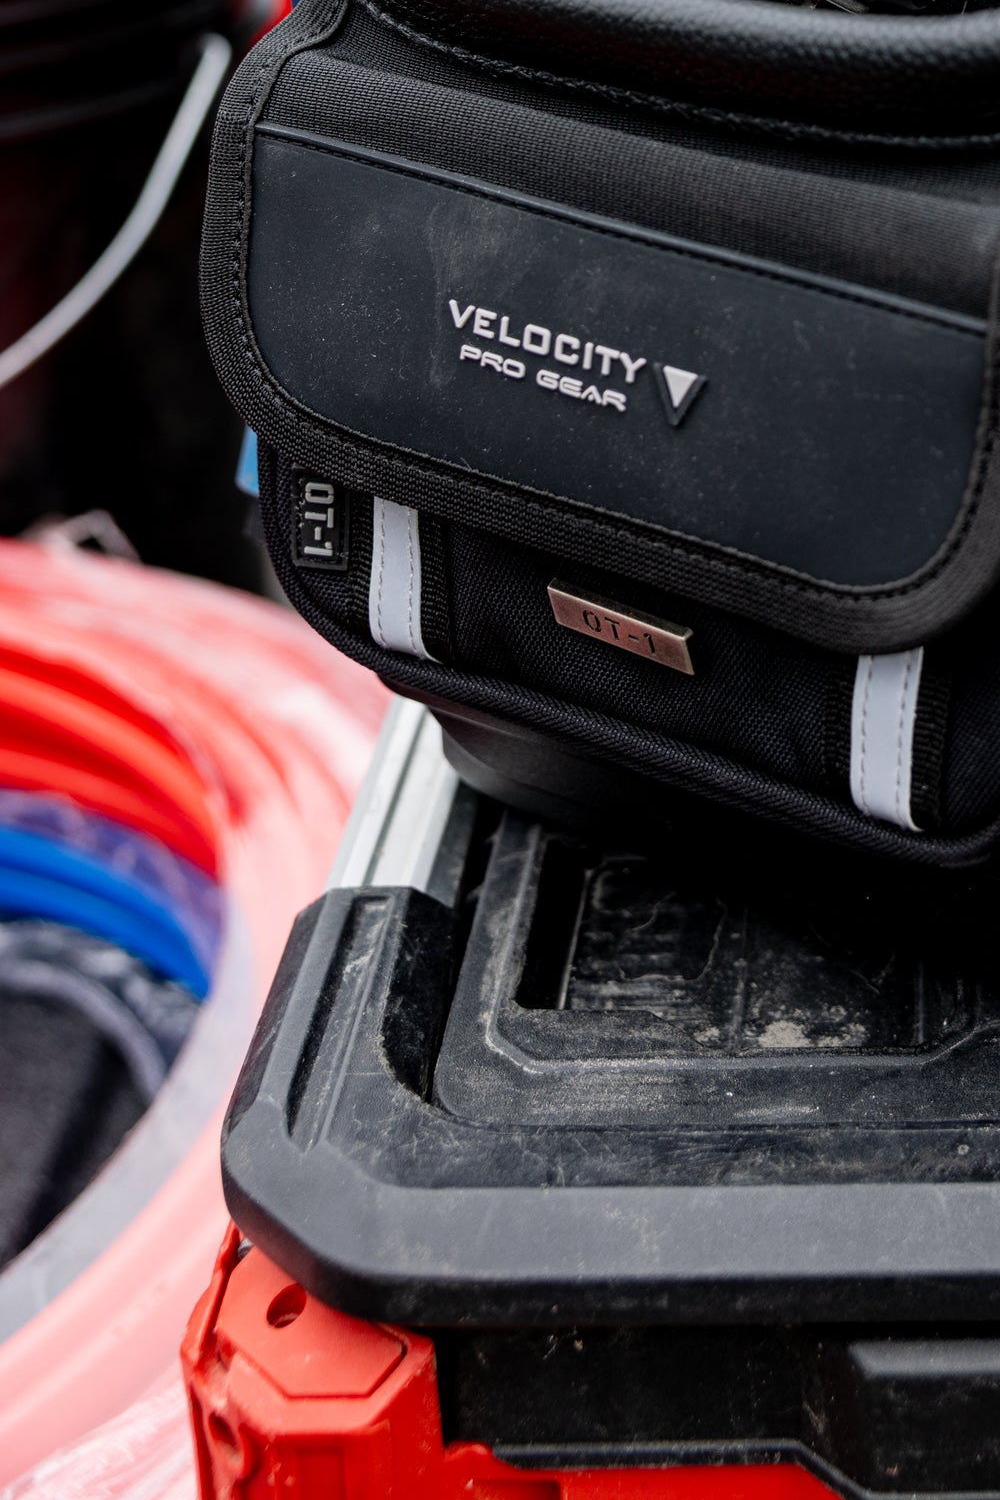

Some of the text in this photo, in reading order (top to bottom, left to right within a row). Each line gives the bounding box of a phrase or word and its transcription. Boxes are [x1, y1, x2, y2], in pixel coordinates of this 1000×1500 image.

[449, 299, 646, 383] VELOCITY
[460, 344, 627, 412] PRO GEAR
